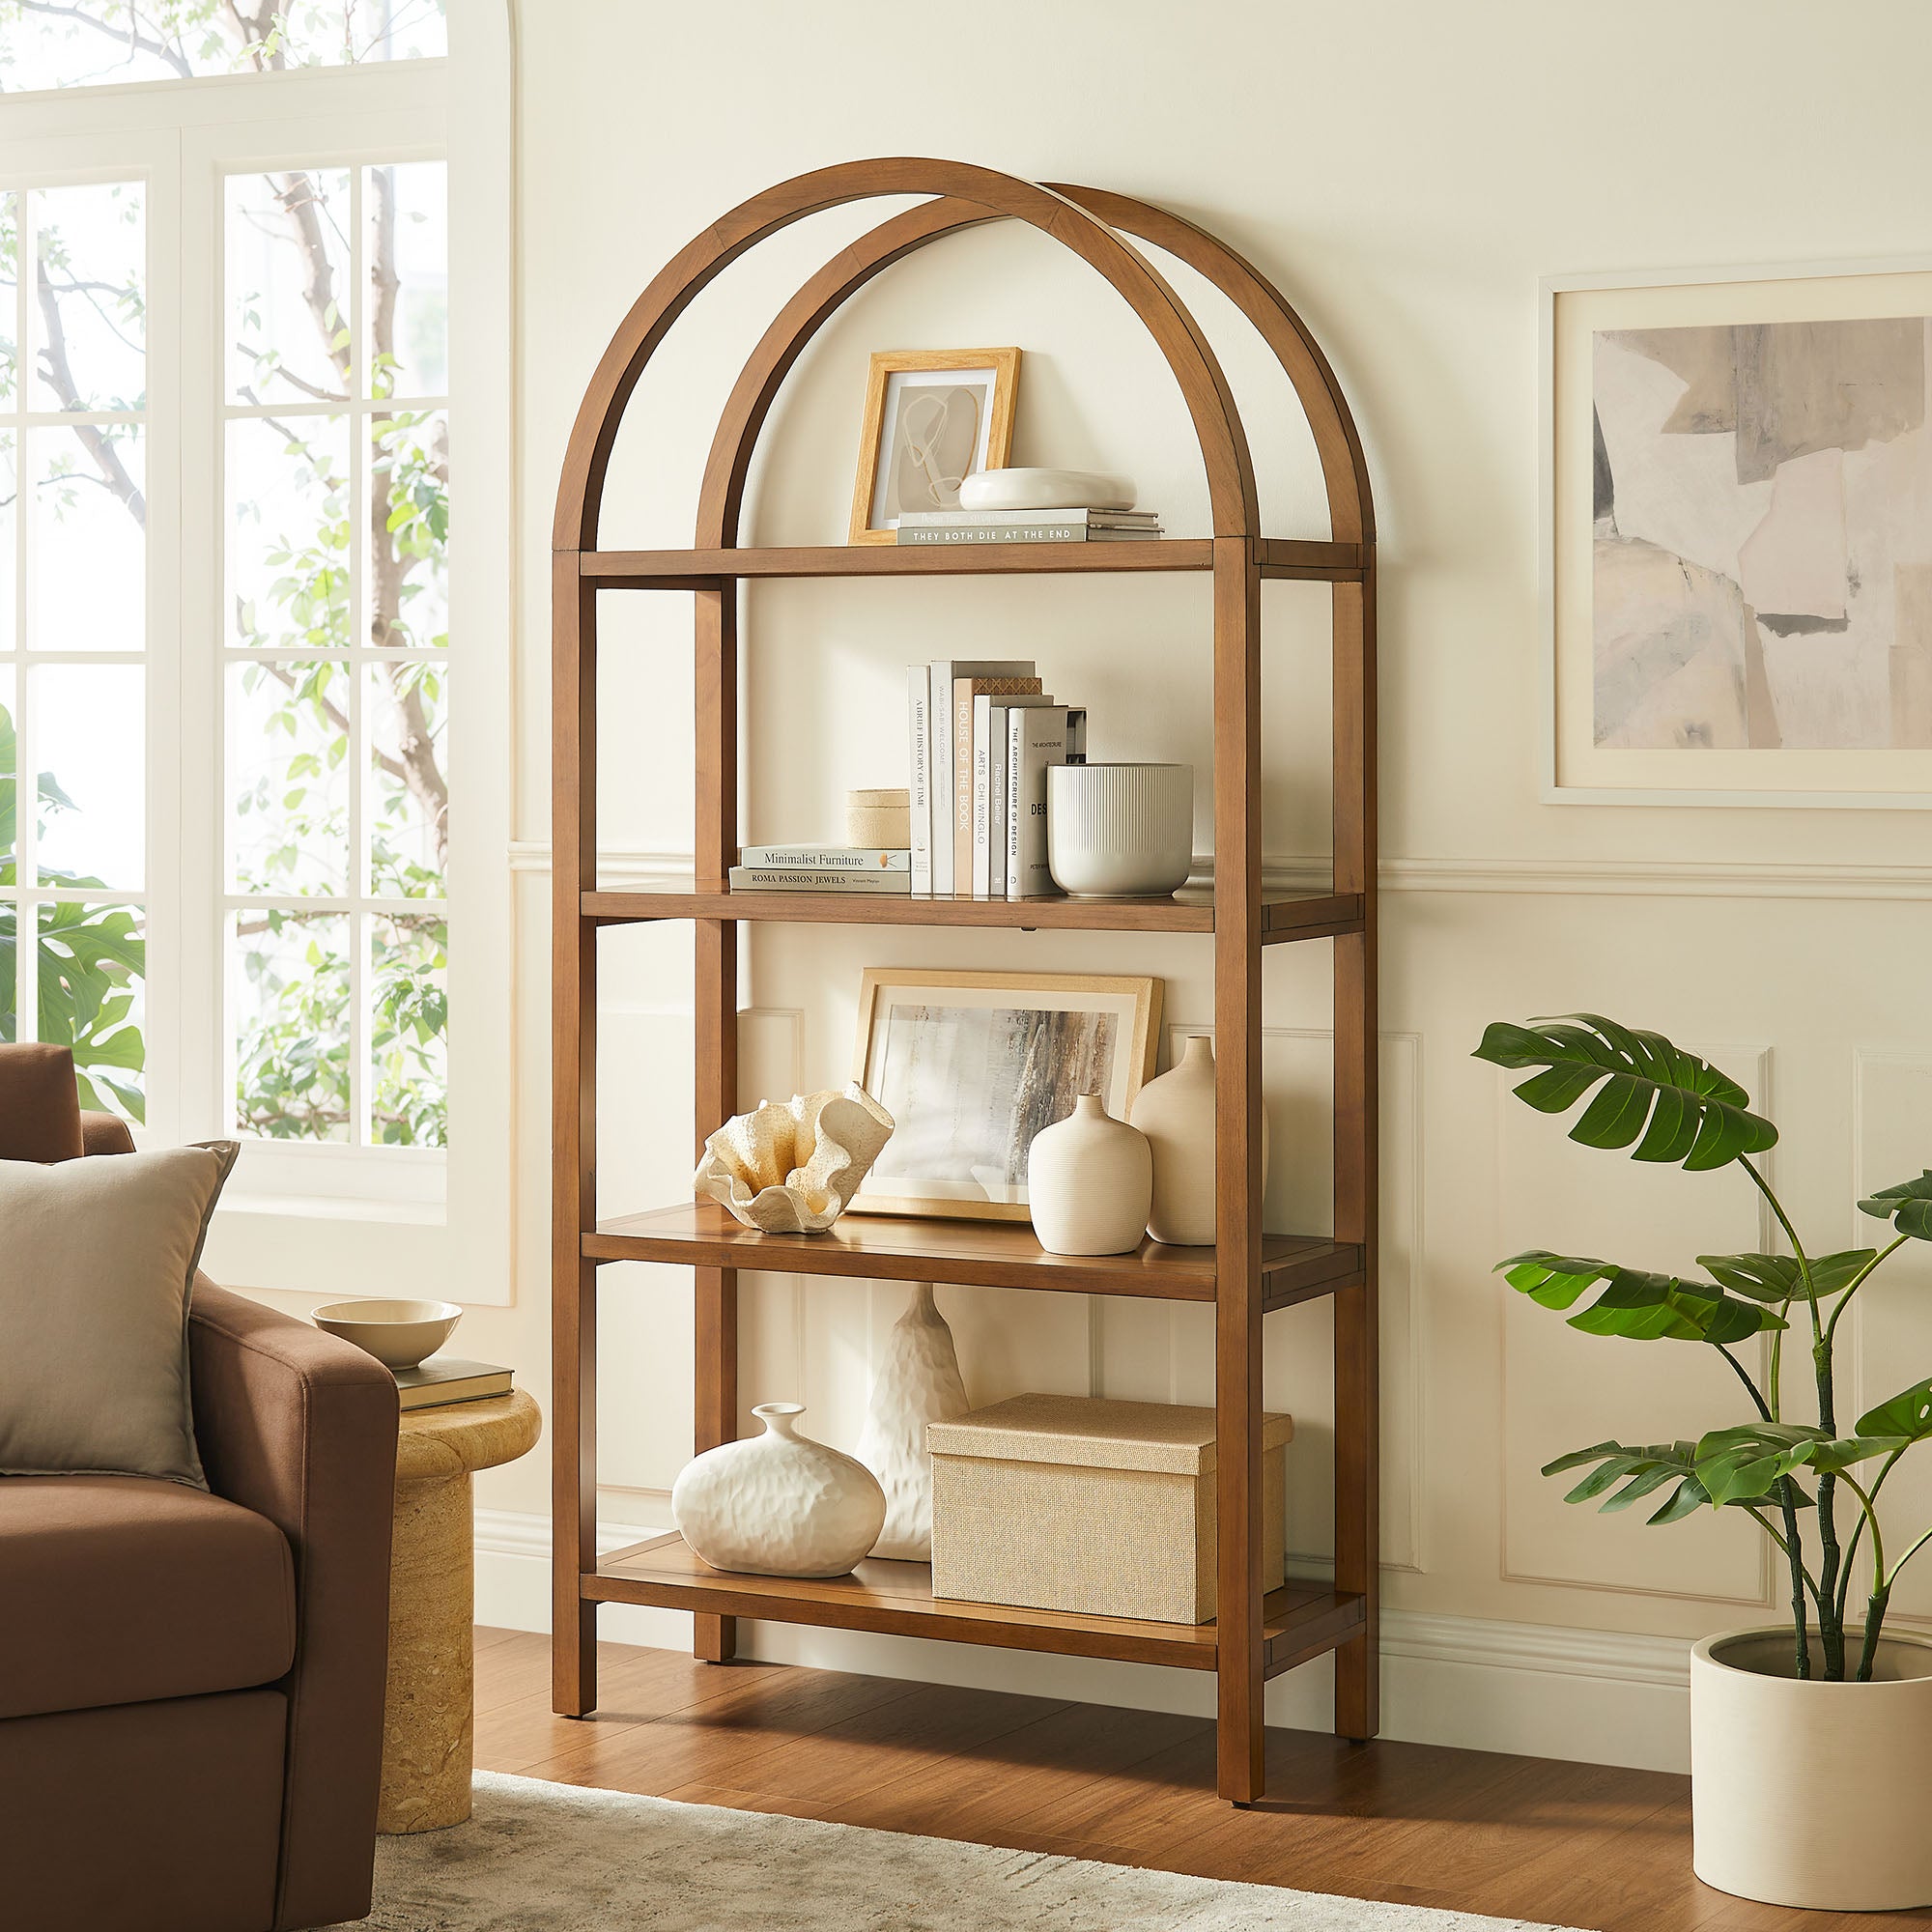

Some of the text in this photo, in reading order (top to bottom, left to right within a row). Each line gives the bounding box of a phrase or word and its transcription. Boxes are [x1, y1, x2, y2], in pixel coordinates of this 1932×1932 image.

[913, 529, 1071, 541] THEY BOTH DIE AT THE END
[958, 701, 969, 831] HOUSE OF THE BOOK
[917, 773, 924, 785] OF
[1031, 803, 1047, 815] DES
[1011, 812, 1017, 822] OF
[764, 853, 864, 867] Minimalist Furniture
[752, 874, 846, 885] ROMA PASSION JEWELS
